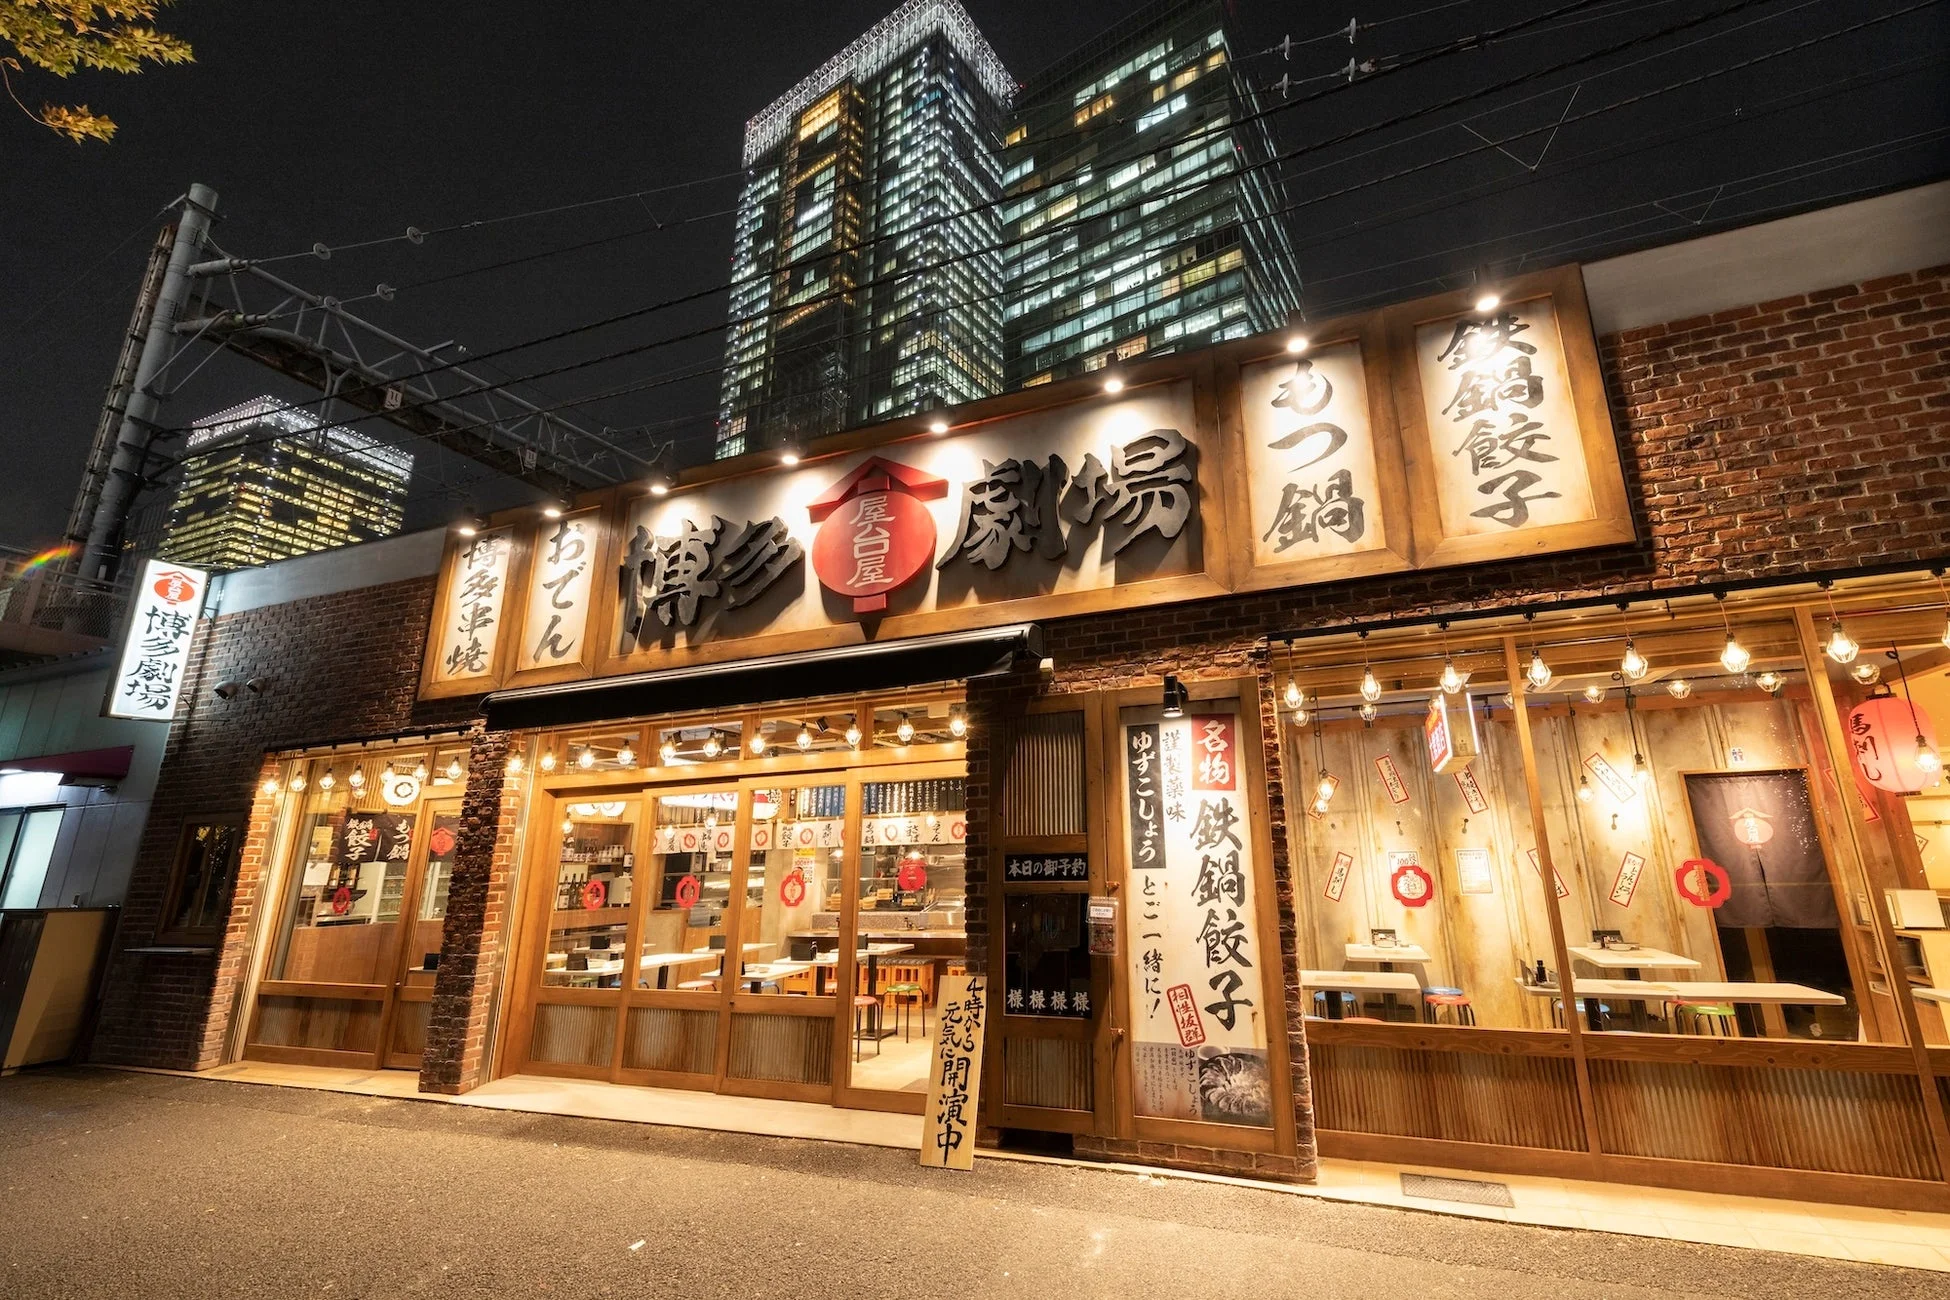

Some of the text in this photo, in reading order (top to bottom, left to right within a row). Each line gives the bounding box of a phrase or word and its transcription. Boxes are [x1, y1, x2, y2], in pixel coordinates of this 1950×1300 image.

[1263, 359, 1365, 553] もつ鍋
[1437, 312, 1562, 528] 鉄鍋餃子
[846, 494, 896, 588] 屋台屋
[935, 428, 1193, 570] 劇場
[446, 533, 506, 676] 博多串焼
[533, 520, 586, 663] おでん
[624, 514, 806, 638] 博多
[125, 605, 192, 711] 博多劇場
[1132, 731, 1159, 863] ゆずこしょう
[1163, 729, 1187, 823] 謹製薬味
[1196, 719, 1230, 785] 名物
[1007, 858, 1087, 878] 本日の御予約
[1190, 796, 1253, 1032] 鉄鍋餃子
[939, 1002, 963, 1060] 元気に
[963, 977, 985, 1053] 4時から
[1007, 988, 1091, 1012] 様 様 様 様
[1172, 987, 1202, 1042] 相性抜群
[936, 1057, 972, 1166] 開演中
[1185, 1048, 1198, 1116] ゆずこしょう
